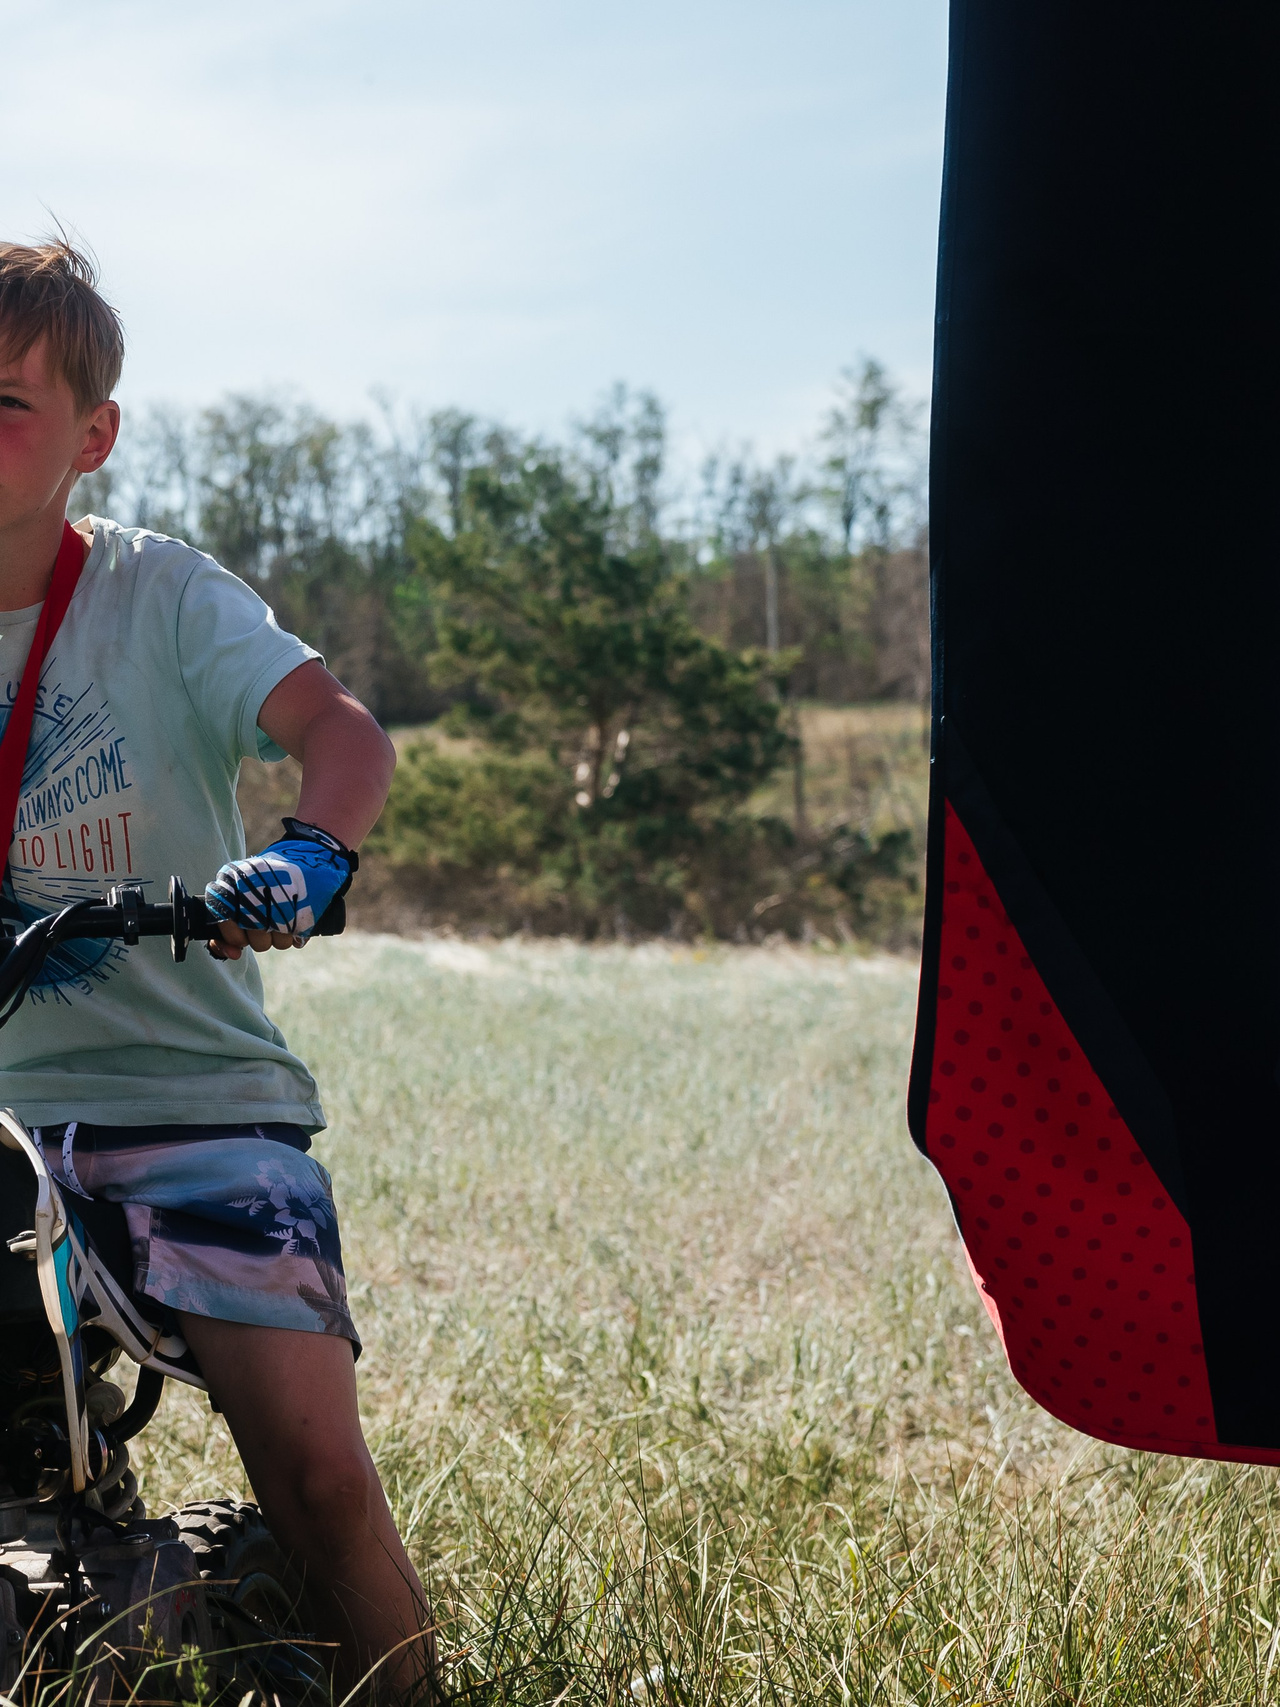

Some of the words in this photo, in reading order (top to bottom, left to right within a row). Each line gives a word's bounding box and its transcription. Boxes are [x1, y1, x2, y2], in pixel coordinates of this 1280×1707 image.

[18, 776, 75, 833] ALWAYS
[75, 736, 133, 806] COME
[18, 835, 46, 868] TO
[53, 812, 132, 875] LIGHT
